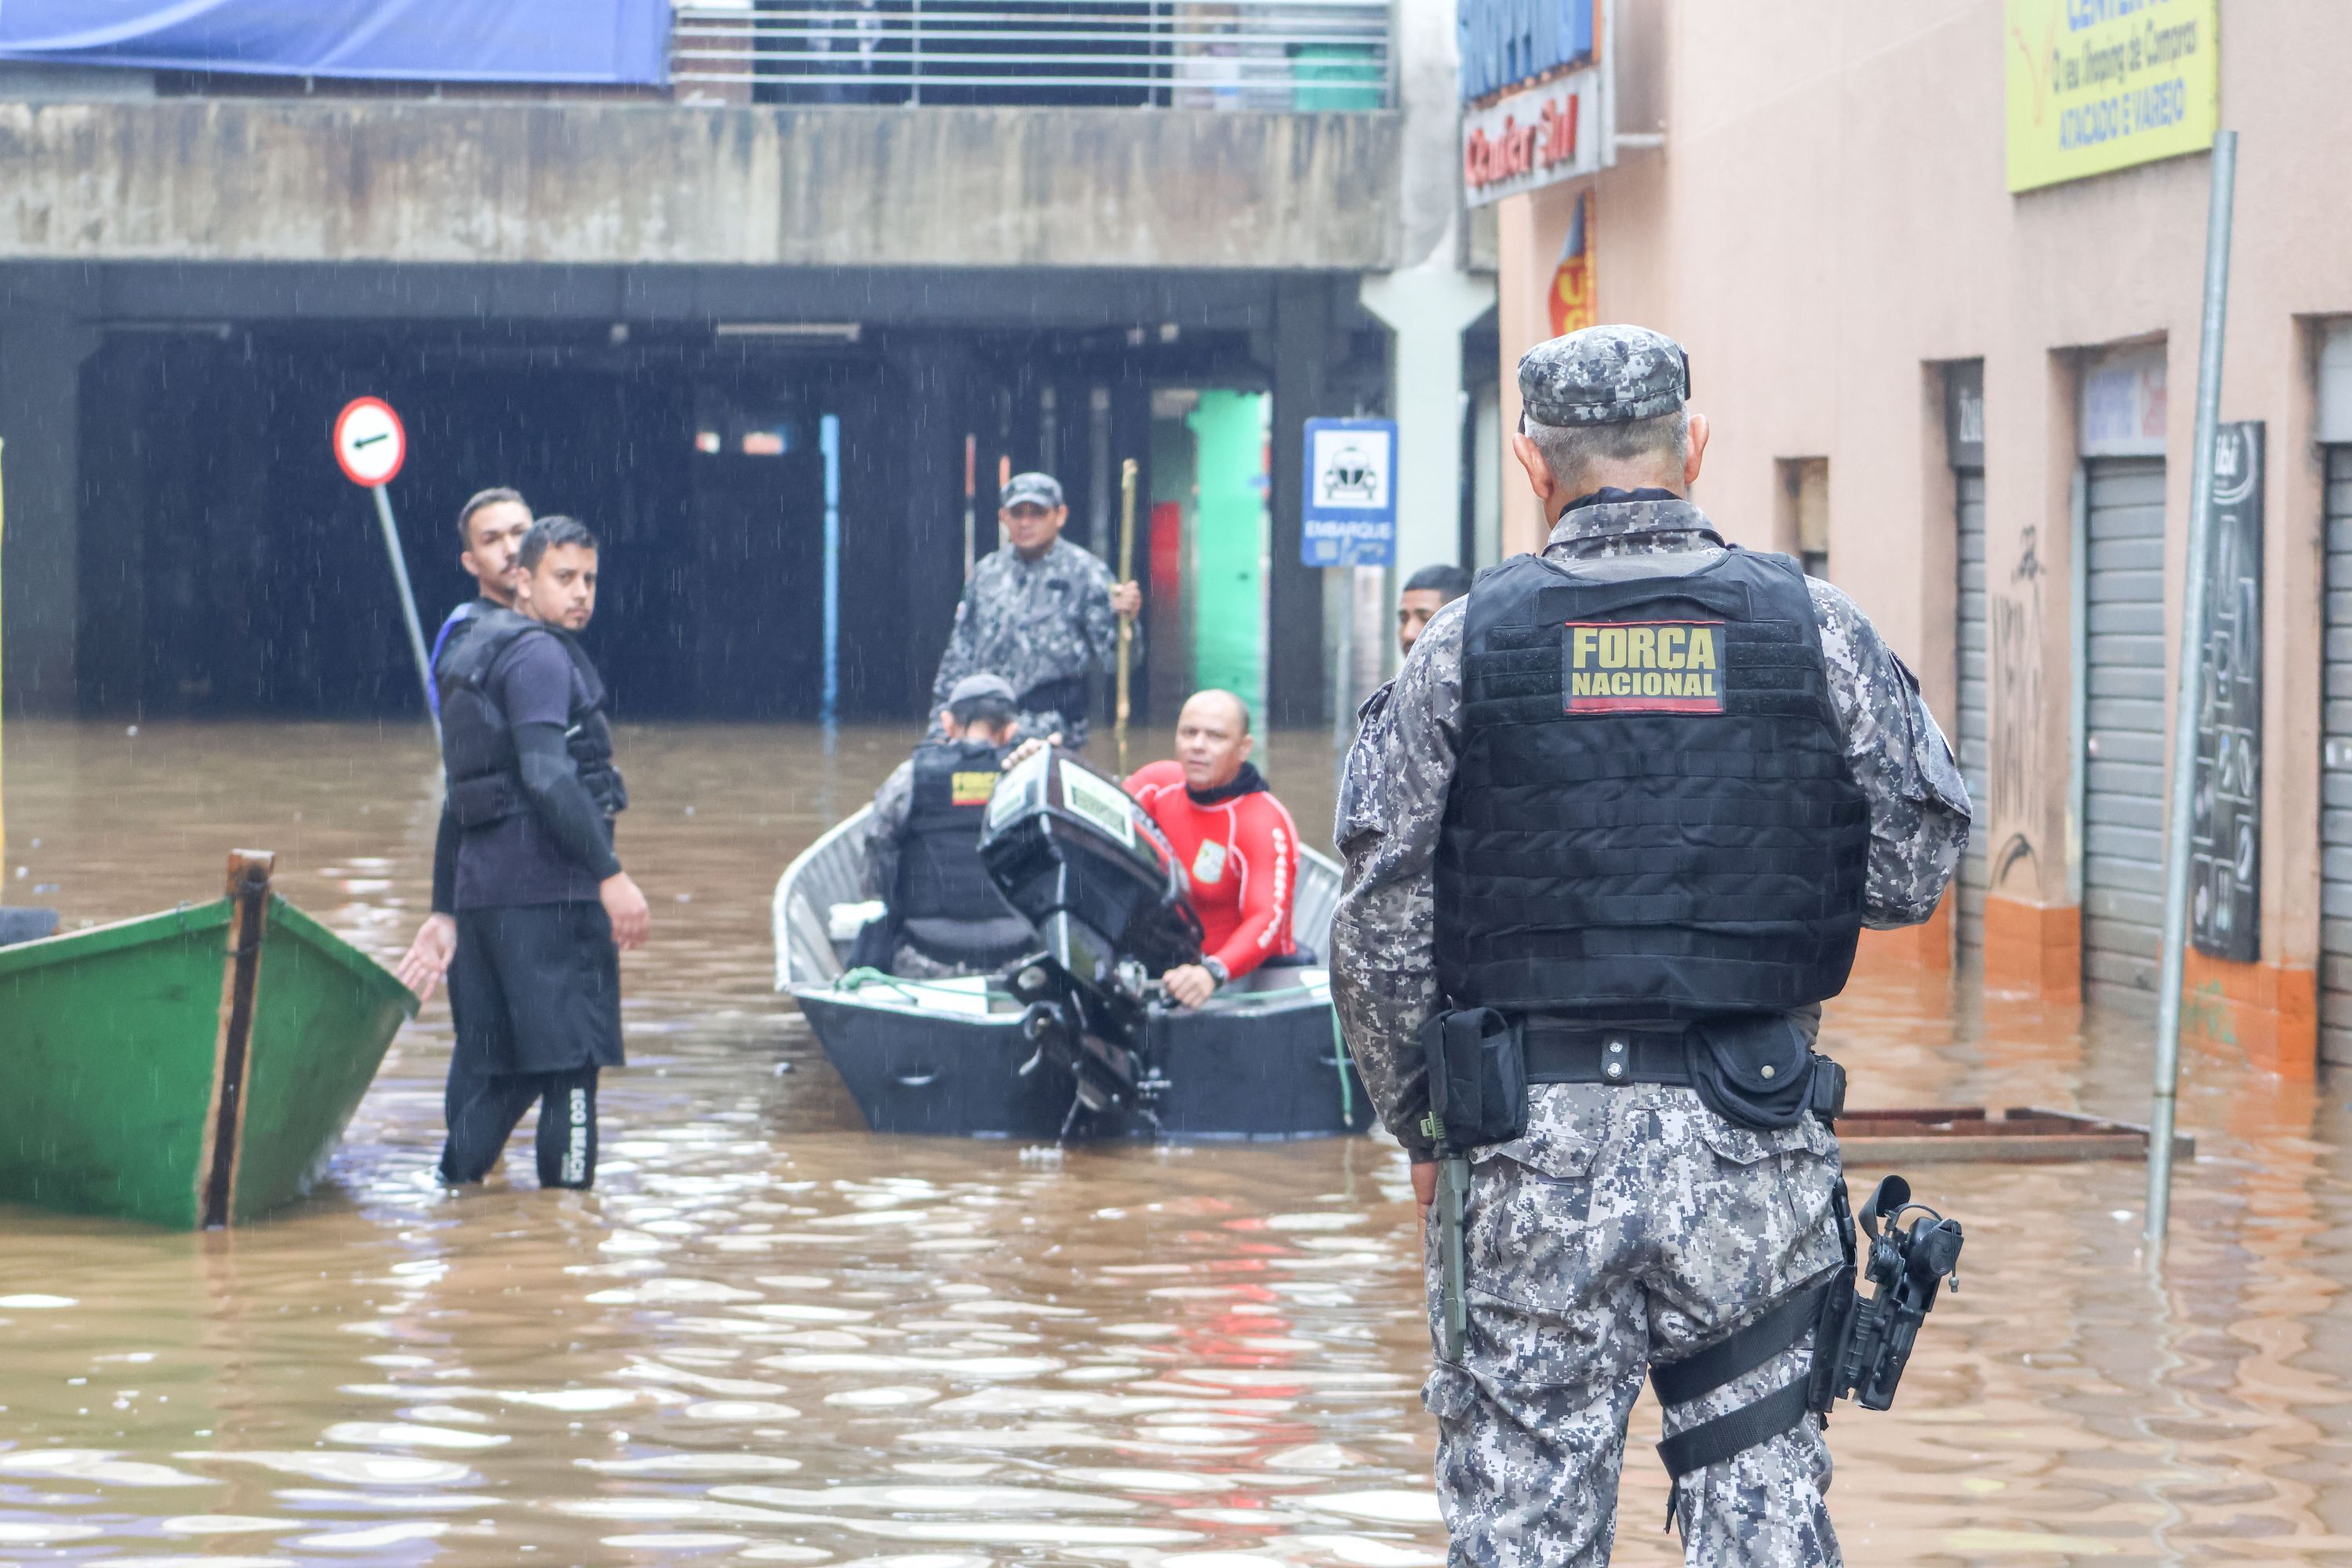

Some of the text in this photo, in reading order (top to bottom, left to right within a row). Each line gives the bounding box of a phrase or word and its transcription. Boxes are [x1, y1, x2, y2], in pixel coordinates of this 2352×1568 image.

[1305, 520, 1392, 539] EMBARQUE
[1573, 627, 1716, 670] FORÇA
[1572, 672, 1717, 696] NACIONAL
